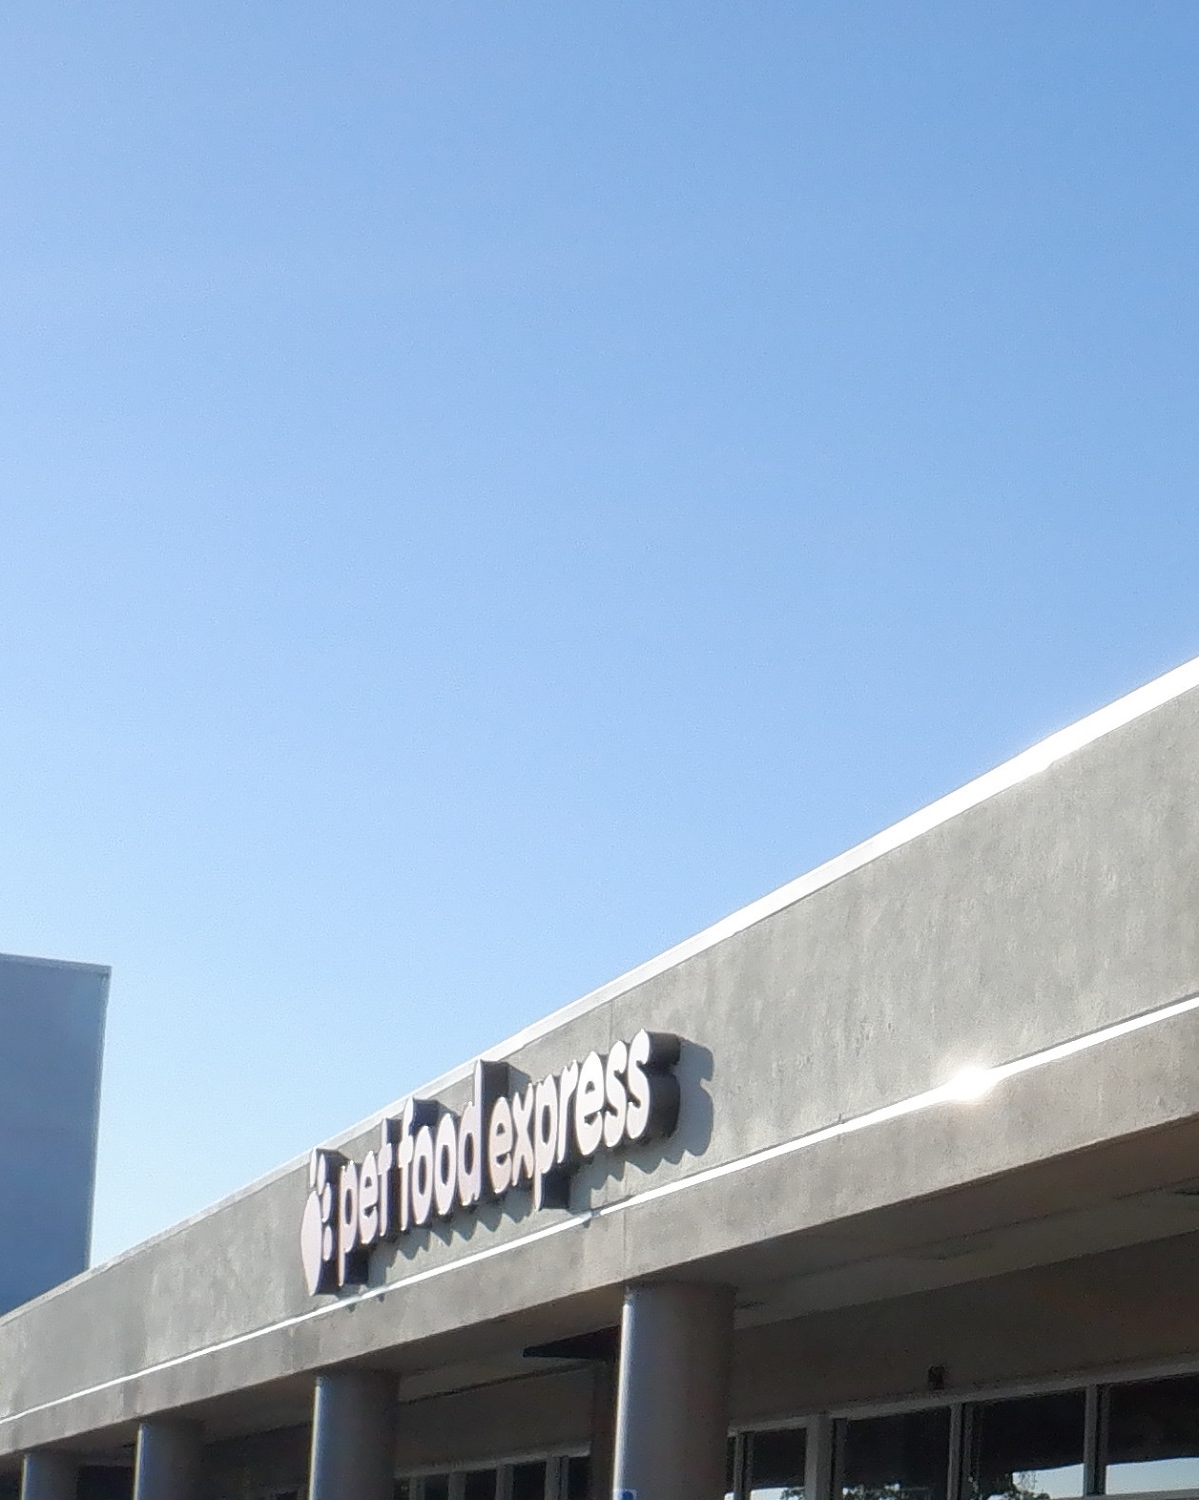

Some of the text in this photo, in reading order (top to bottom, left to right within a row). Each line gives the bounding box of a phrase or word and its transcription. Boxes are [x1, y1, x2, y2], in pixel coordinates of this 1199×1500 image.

[338, 1028, 654, 1288] pet food express
